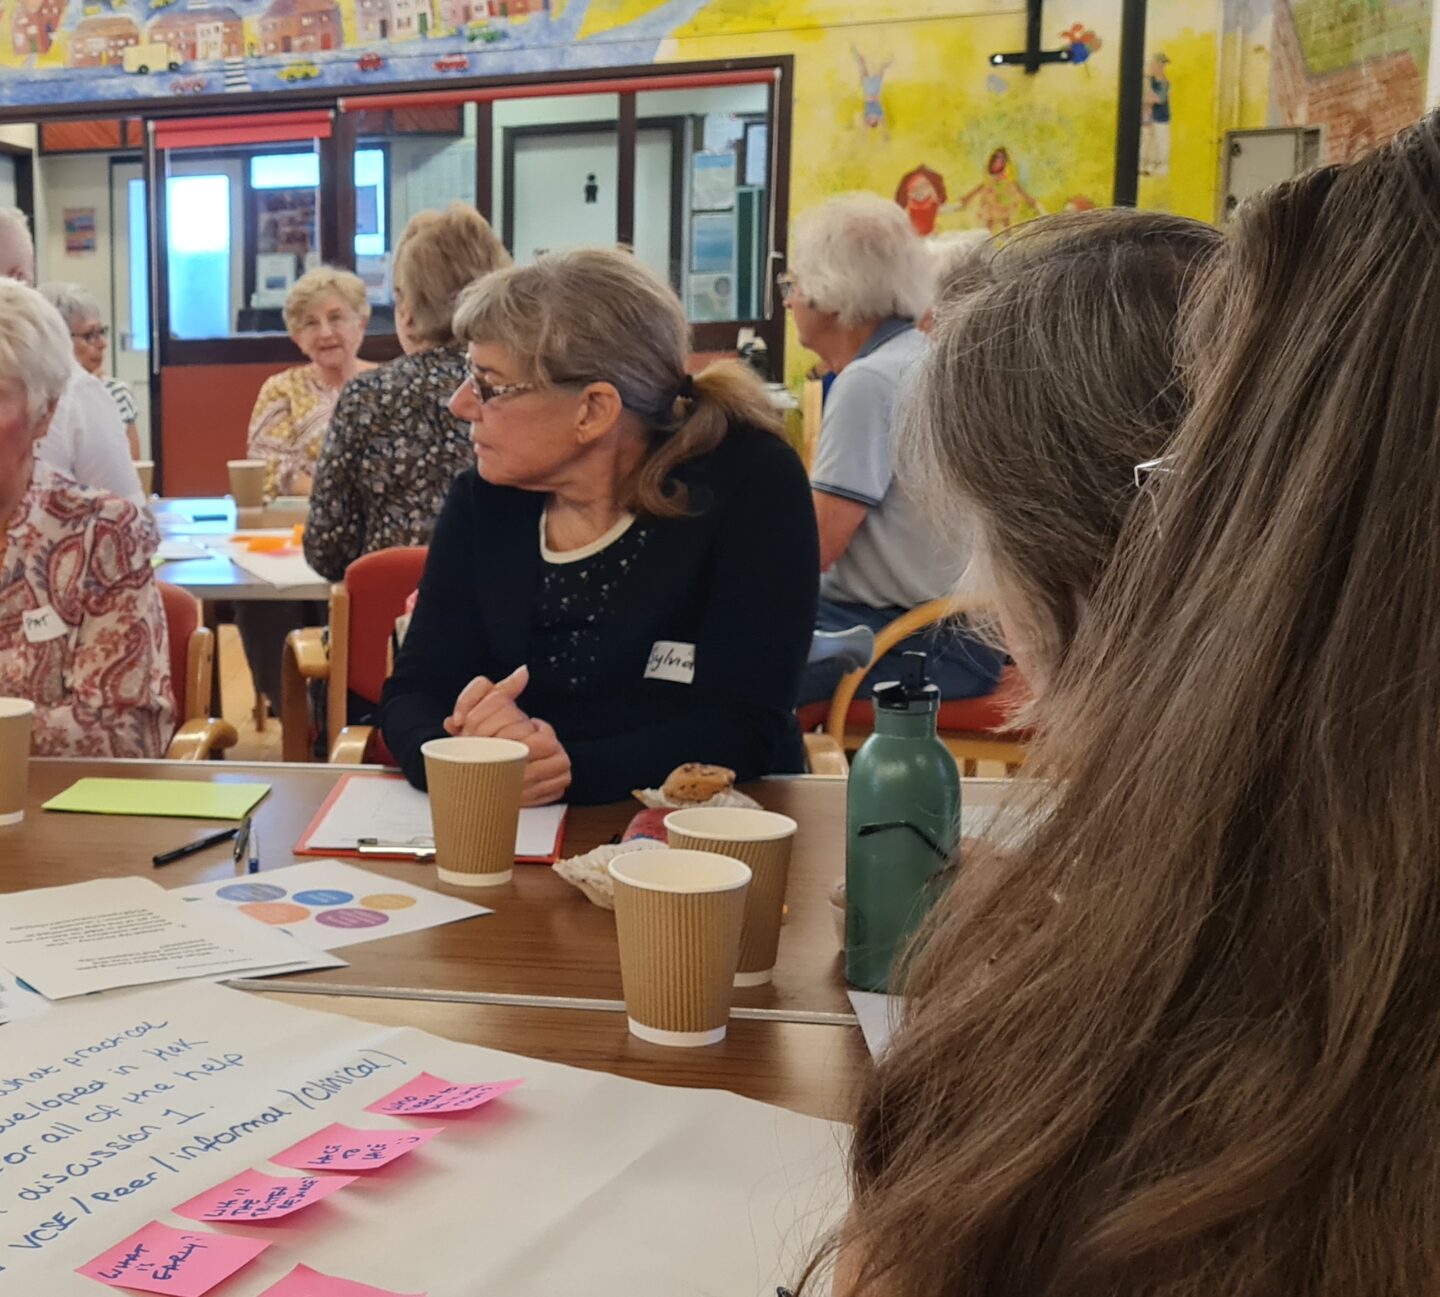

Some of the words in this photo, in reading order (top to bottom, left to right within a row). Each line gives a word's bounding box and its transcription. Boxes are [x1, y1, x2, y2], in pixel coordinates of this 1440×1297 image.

[64, 1021, 168, 1067] practical
[108, 1064, 139, 1076] in
[3, 1144, 37, 1165] or
[41, 1122, 83, 1144] all
[85, 1104, 123, 1123] of
[122, 1082, 175, 1105] the
[173, 1053, 246, 1081] help
[8, 1211, 78, 1249] VCSE
[170, 1105, 292, 1160] informal
[18, 1123, 162, 1201] discussion
[98, 1244, 149, 1280] WHAT
